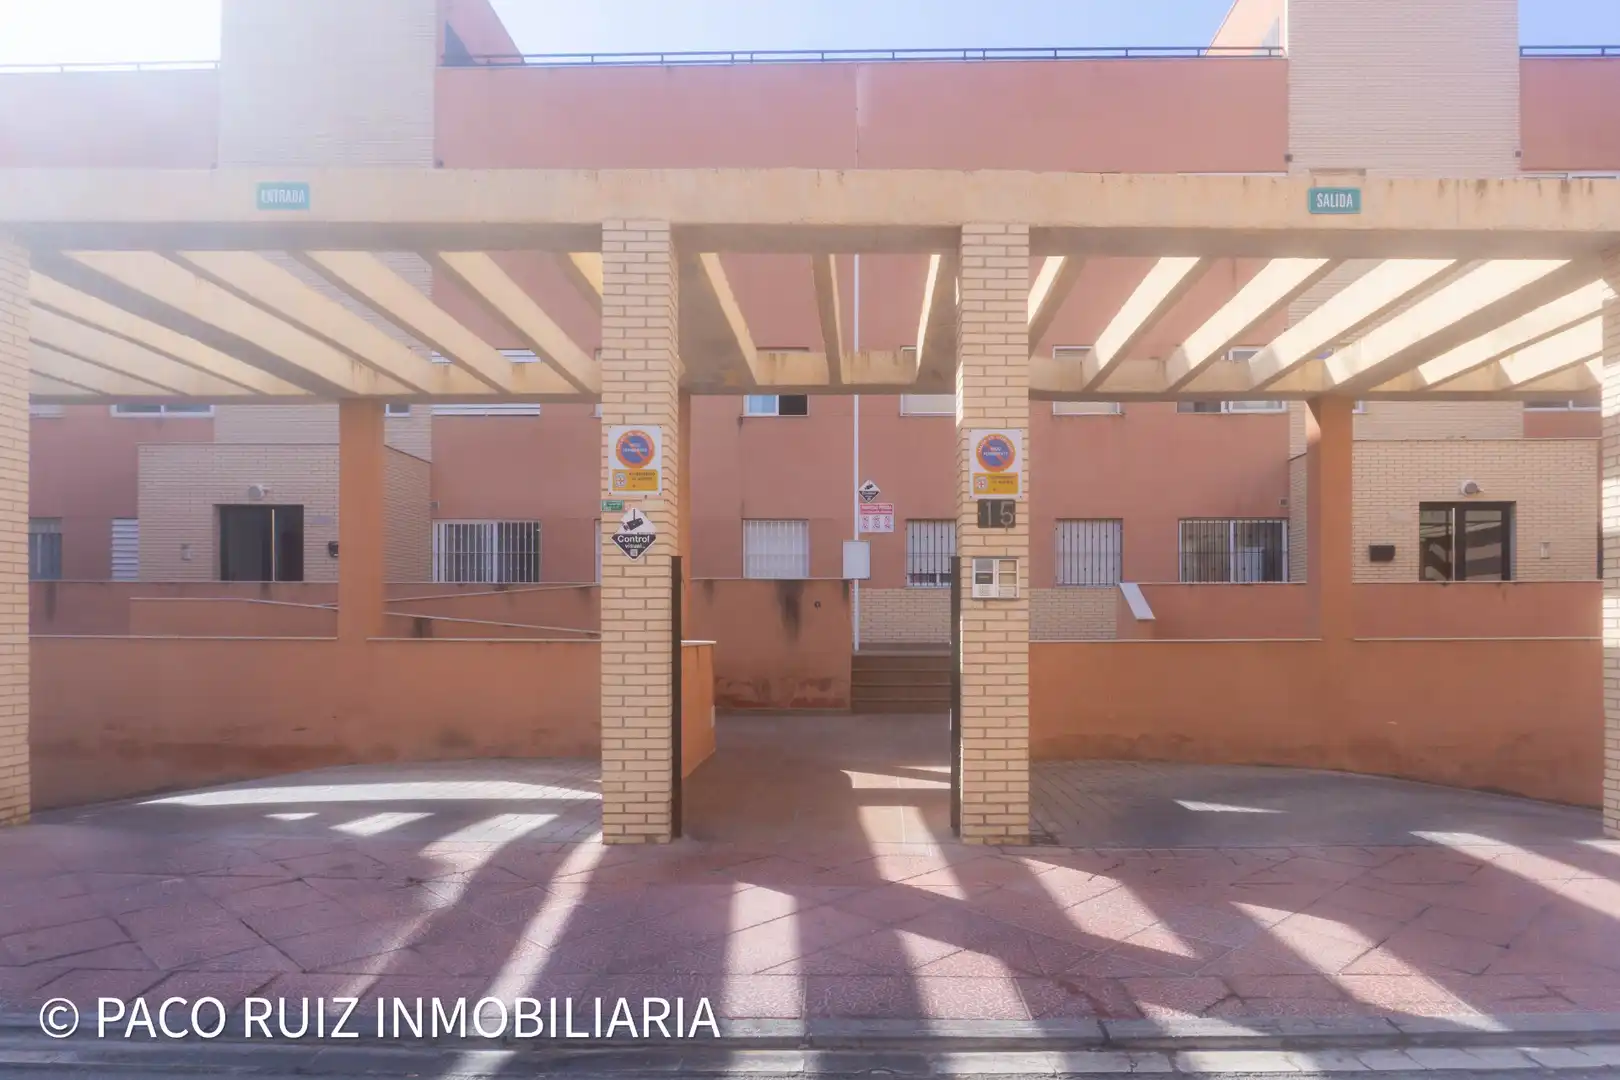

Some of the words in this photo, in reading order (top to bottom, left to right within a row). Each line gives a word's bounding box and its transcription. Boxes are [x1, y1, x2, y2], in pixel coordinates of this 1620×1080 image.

[261, 189, 305, 203] ENTRADA
[1316, 192, 1353, 208] SALIDA
[985, 501, 1014, 528] 15
[617, 535, 650, 543] Control
